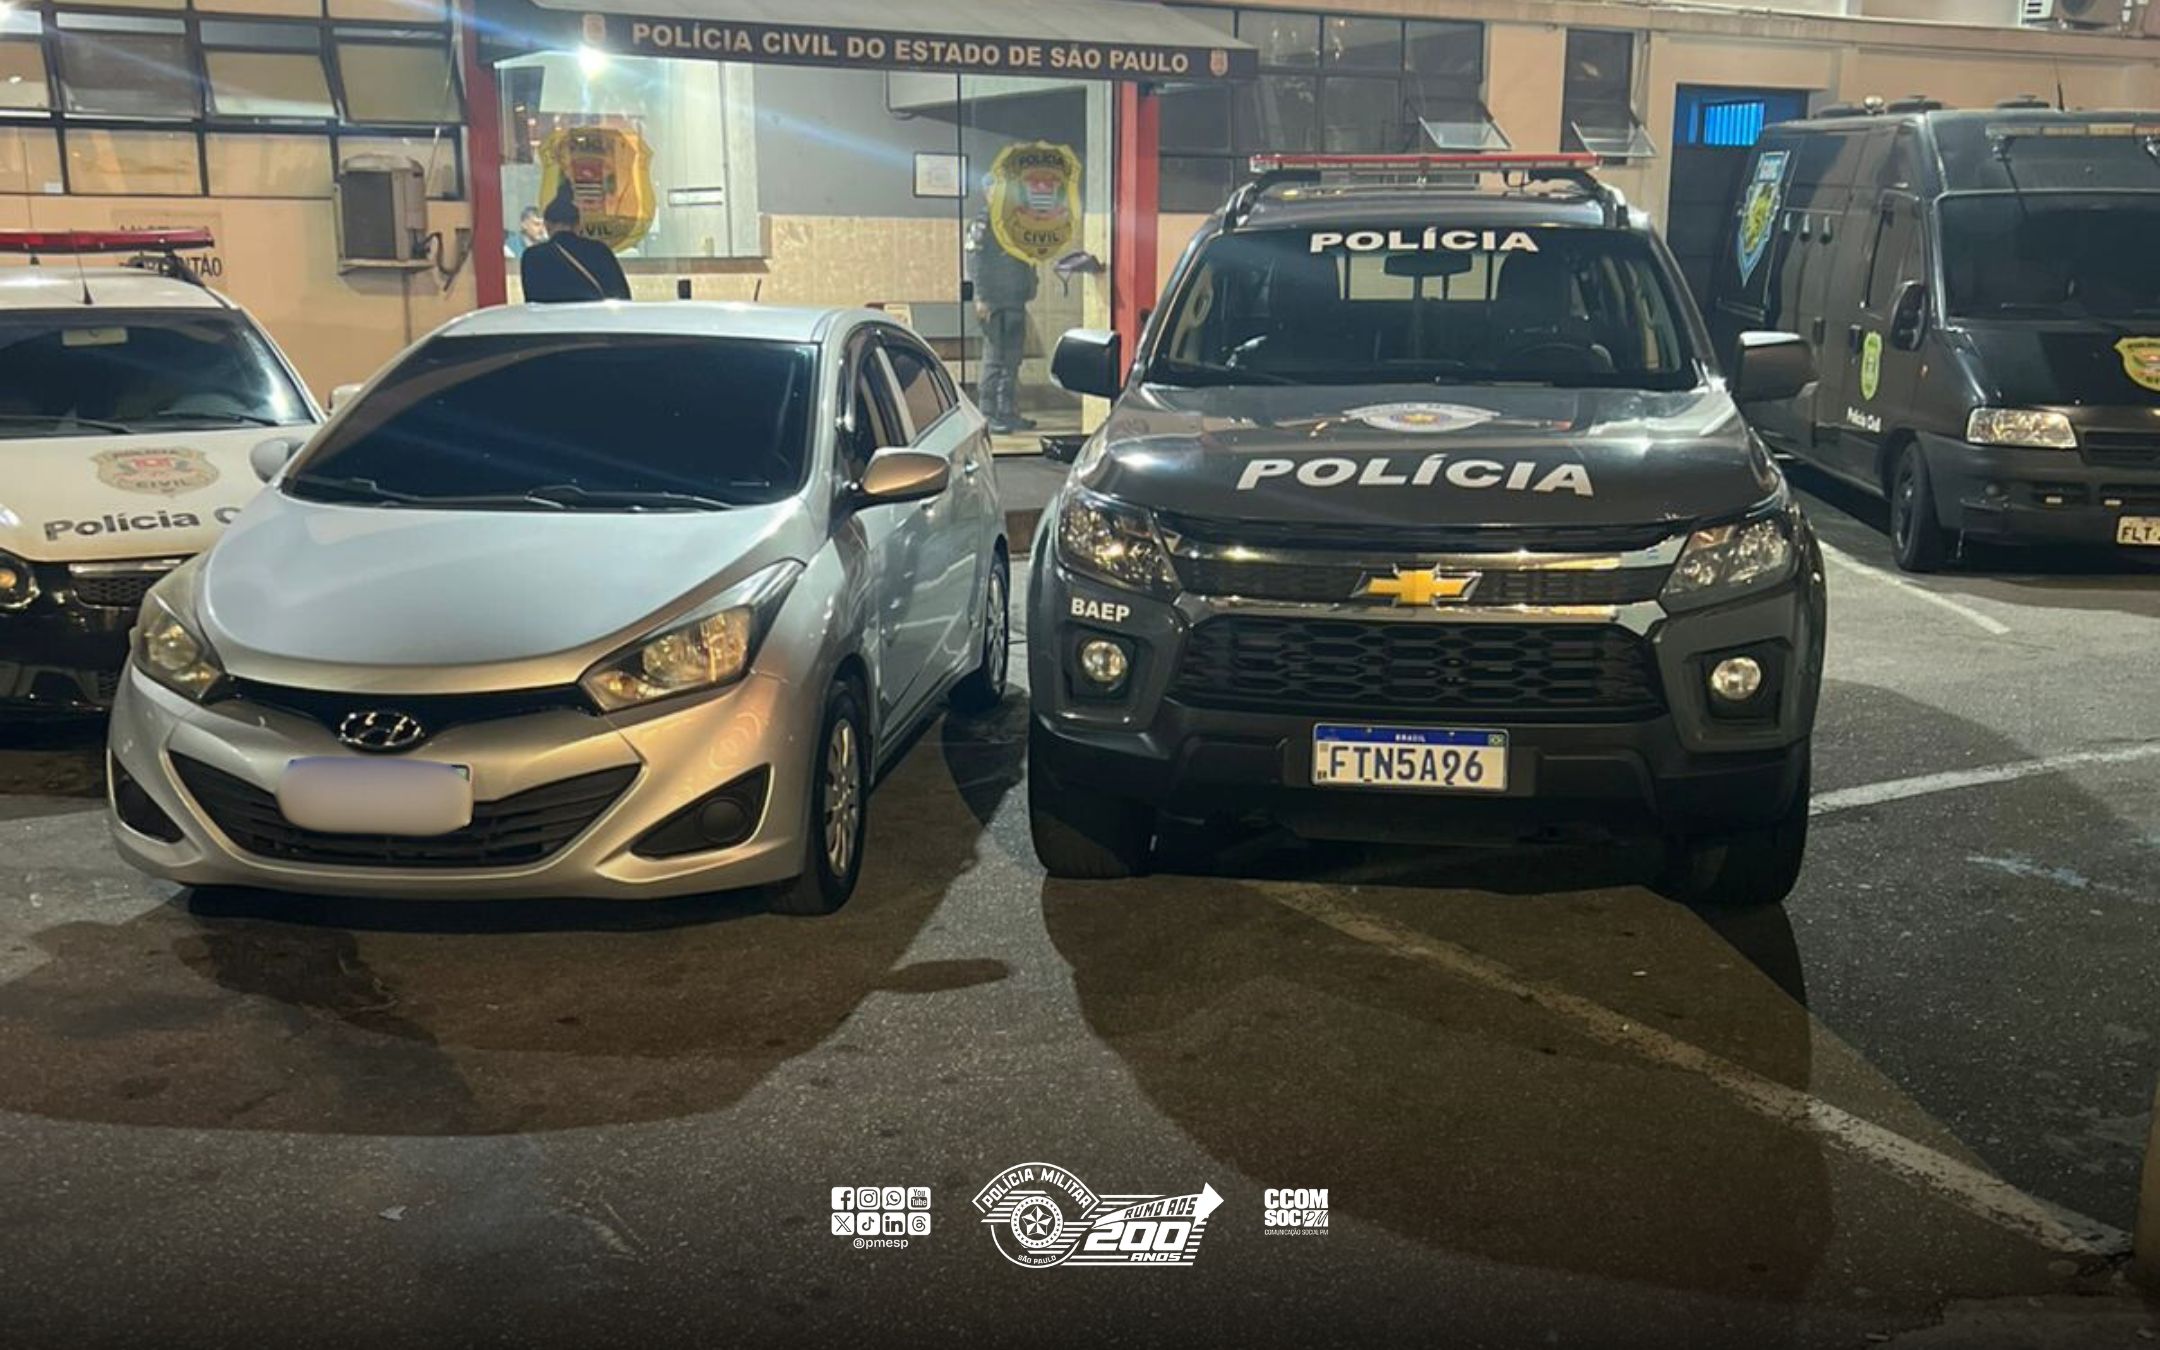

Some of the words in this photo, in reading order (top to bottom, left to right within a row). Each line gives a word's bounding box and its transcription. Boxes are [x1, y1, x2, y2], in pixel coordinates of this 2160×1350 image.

[632, 23, 752, 51] POLÍCIA
[762, 31, 837, 56] CIVIL
[847, 37, 885, 58] DO
[895, 39, 1000, 65] ESTADO
[1008, 49, 1042, 67] DE
[1050, 45, 1101, 69] SÃO
[1110, 51, 1189, 73] PAULO
[1023, 231, 1059, 243] CIVIL
[1310, 227, 1539, 252] POLÍCIA
[1236, 453, 1595, 497] POLÍCIA
[44, 510, 200, 542] Polícia
[1071, 597, 1130, 622] BAEP
[1330, 746, 1483, 785] FTN5A96
